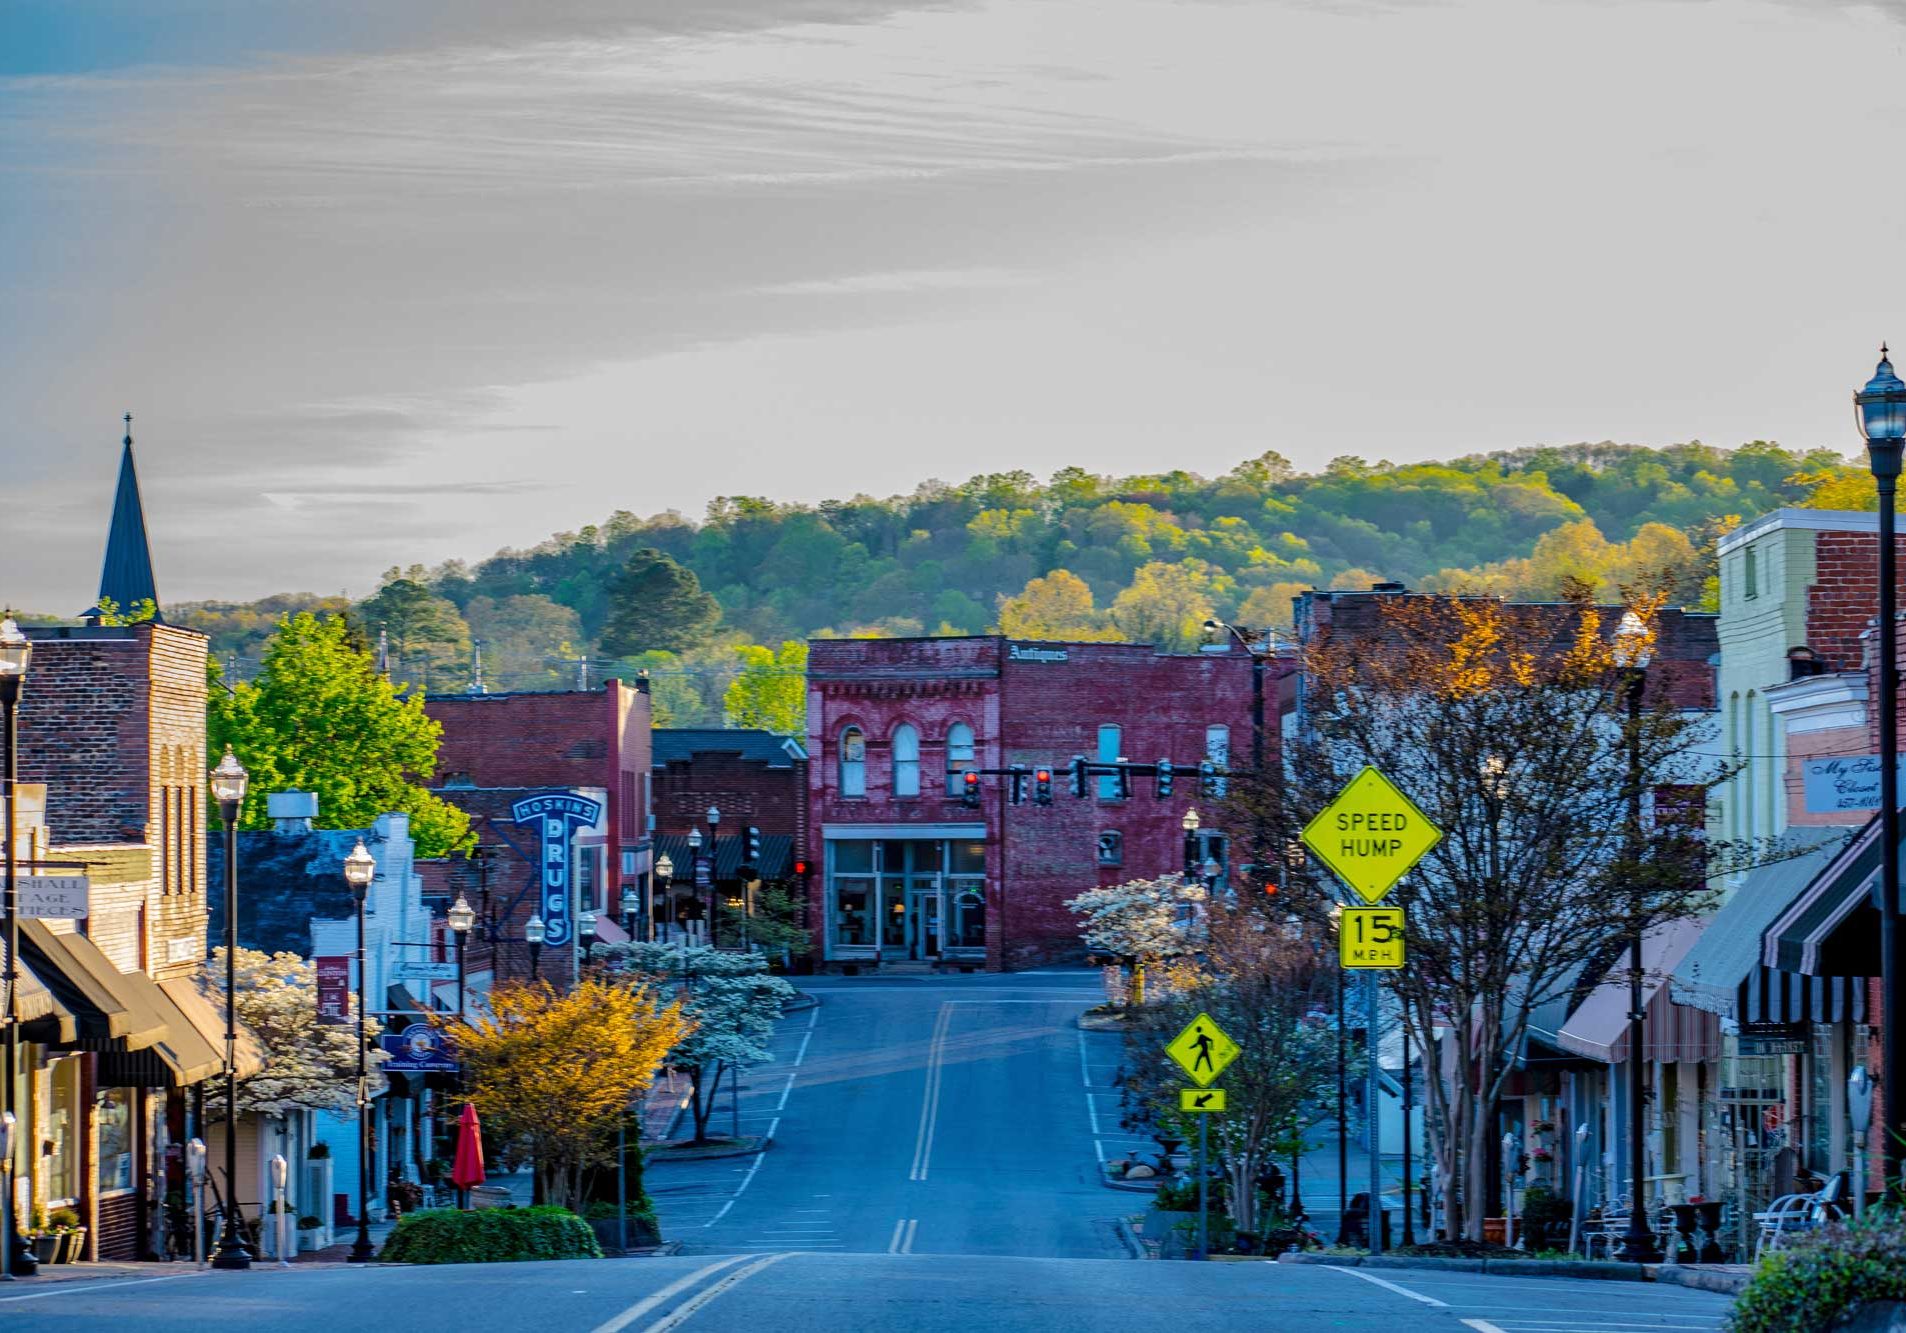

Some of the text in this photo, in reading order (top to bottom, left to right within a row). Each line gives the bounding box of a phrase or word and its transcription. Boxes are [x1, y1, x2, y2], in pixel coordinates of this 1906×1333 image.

[1008, 645, 1068, 663] Antiques
[1811, 760, 1848, 779] My
[519, 799, 595, 817] HOSKINS
[1336, 813, 1407, 831] SPEED
[1340, 839, 1402, 857] HUMP
[547, 818, 565, 938] DRUGS
[1354, 915, 1394, 943] 15
